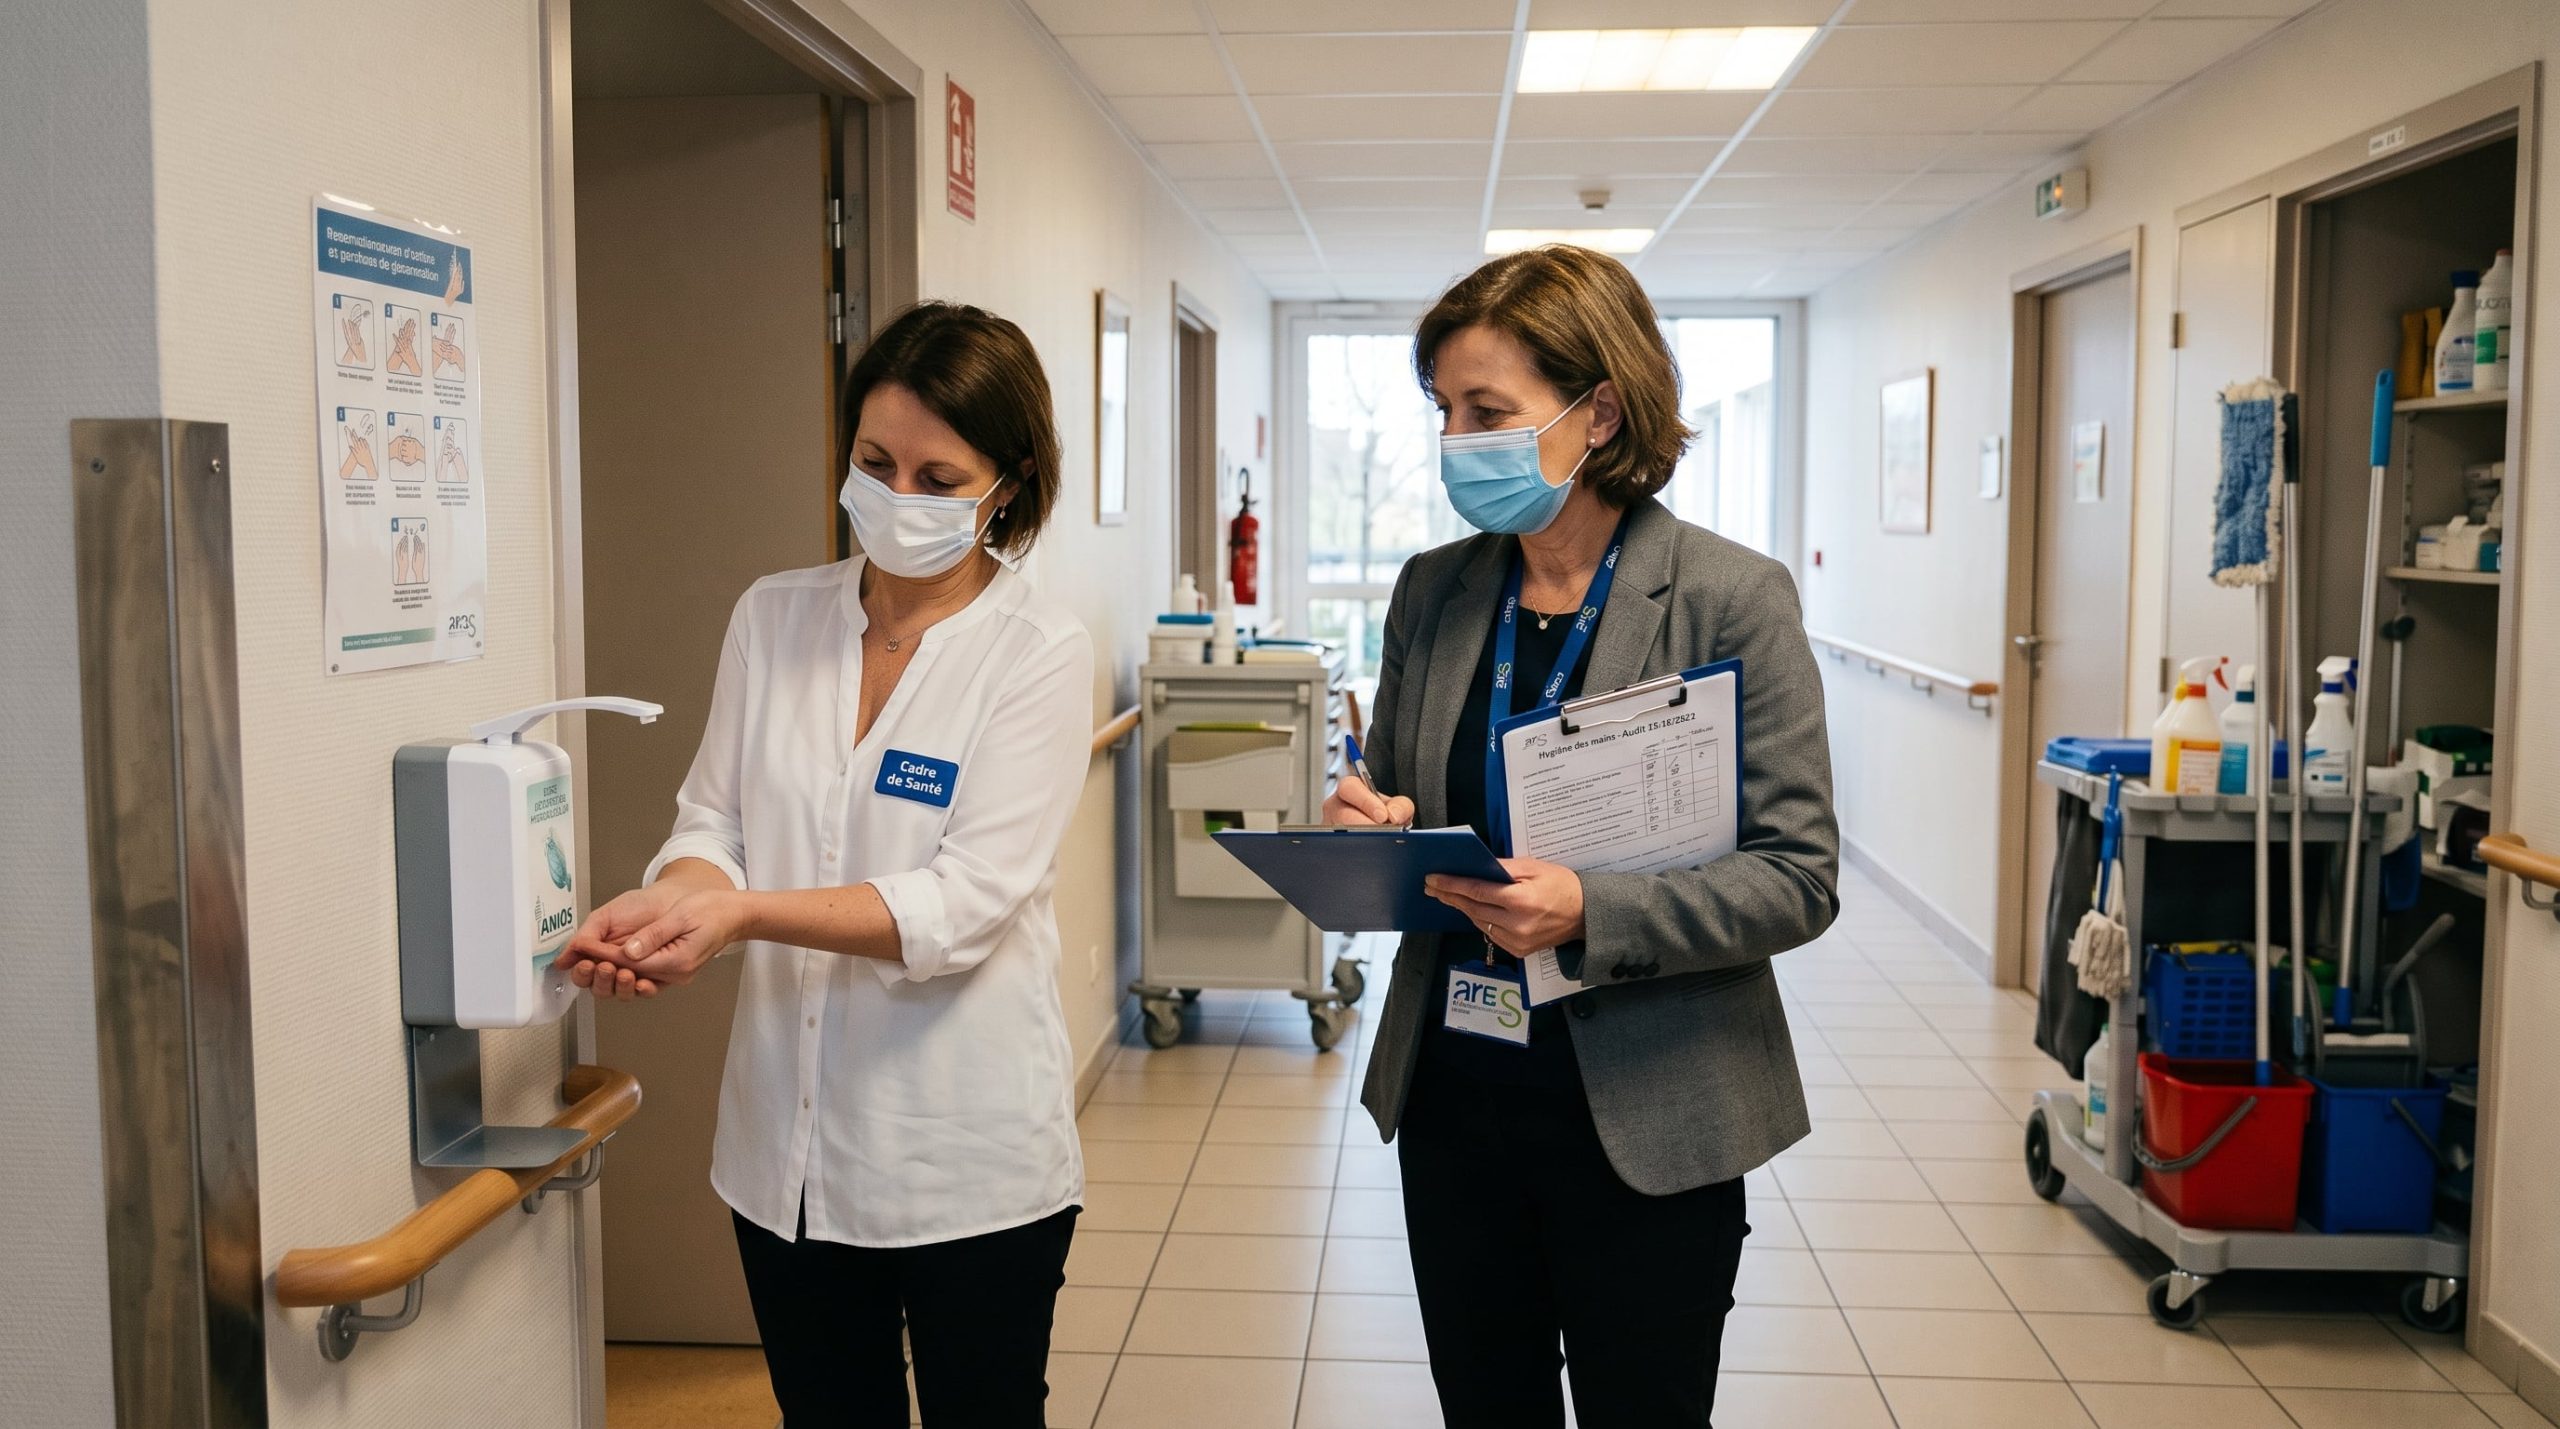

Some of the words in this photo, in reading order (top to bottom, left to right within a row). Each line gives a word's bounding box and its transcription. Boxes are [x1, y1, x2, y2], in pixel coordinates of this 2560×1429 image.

[379, 257, 390, 270] de
[1574, 741, 1589, 750] des
[1591, 734, 1616, 746] mains
[1622, 725, 1646, 738] Audit
[900, 760, 937, 779] Cadre
[886, 773, 903, 787] de
[904, 776, 943, 796] Santé
[541, 906, 573, 937] ANIOS
